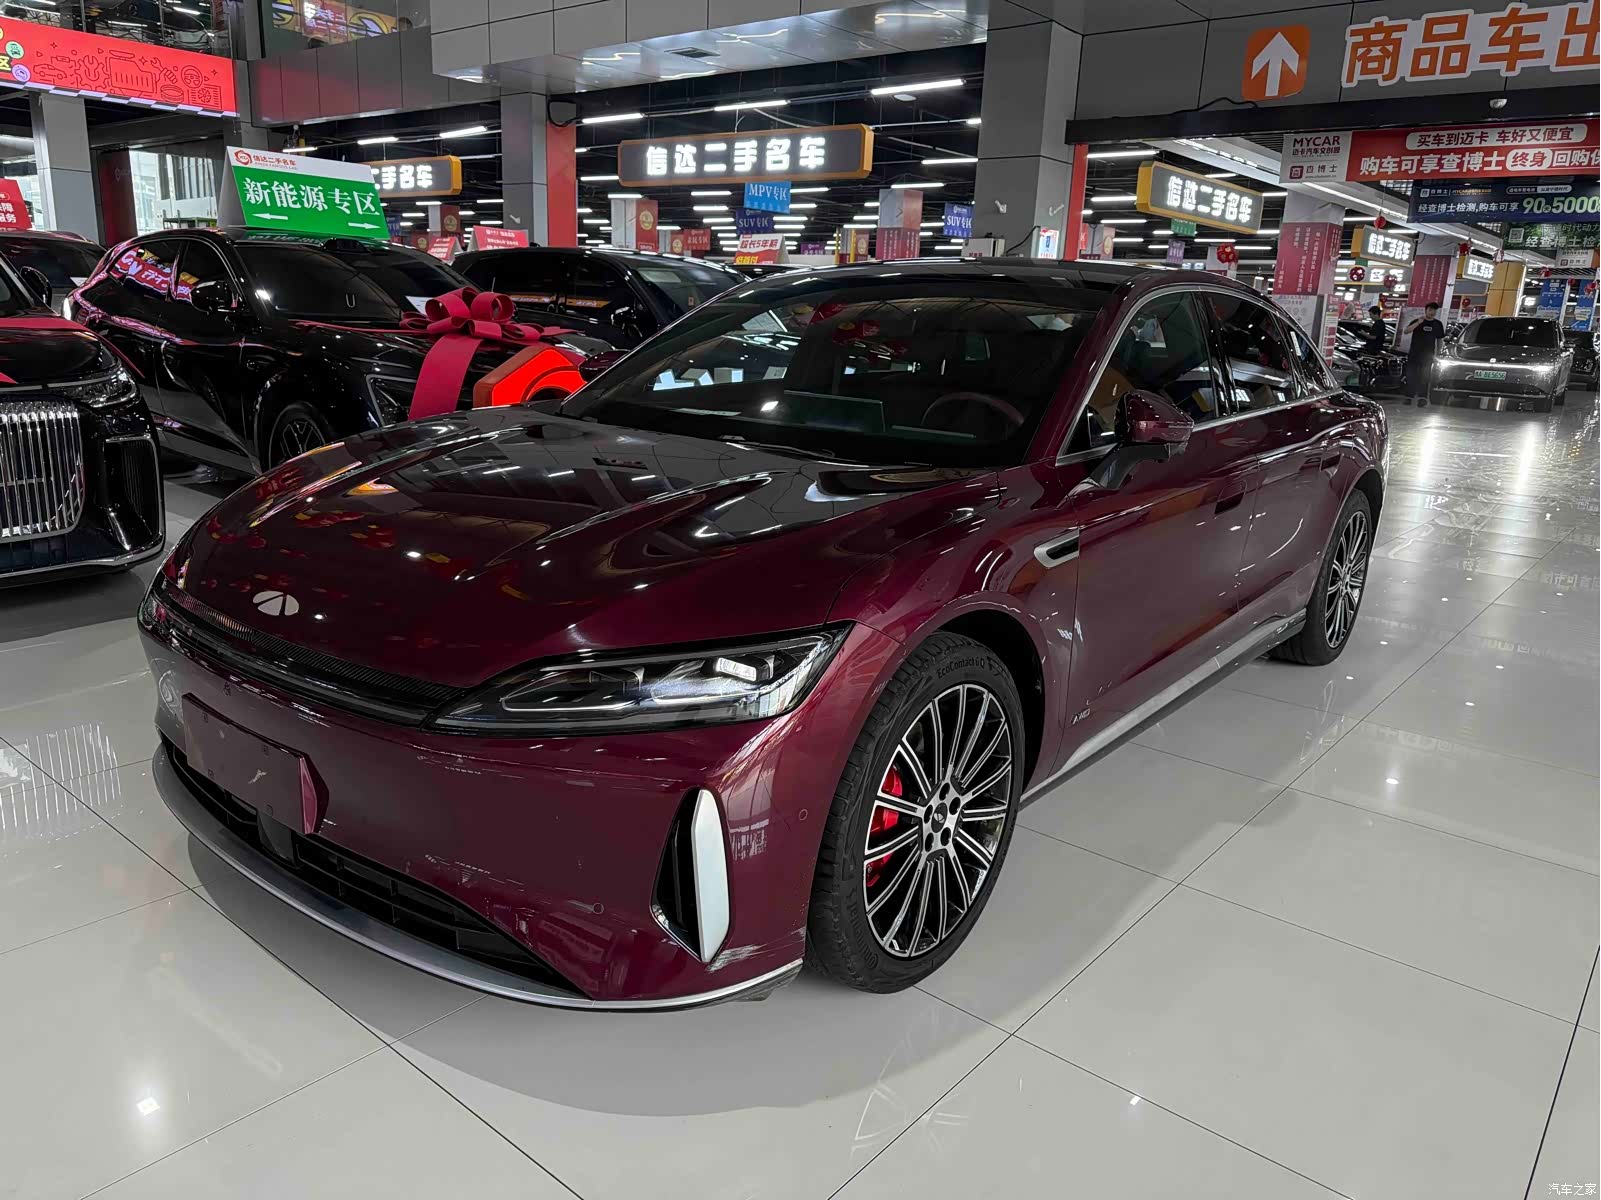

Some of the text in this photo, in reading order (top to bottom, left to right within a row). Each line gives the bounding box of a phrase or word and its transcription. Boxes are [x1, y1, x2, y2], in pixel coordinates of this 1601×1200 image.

[1293, 136, 1341, 147] MYCAR
[1417, 126, 1575, 148] 买车到迈卡 车好又便宜
[253, 154, 297, 165] 信达二手名车
[646, 137, 825, 175] 信达二手名车
[1306, 164, 1338, 173] 查博士
[242, 177, 380, 215] 新能源专区
[1167, 175, 1253, 223] 信达二手名车
[0, 203, 14, 213] 障
[1368, 232, 1411, 260] 信达二手名车
[1525, 235, 1600, 248] 经查博士检
[937, 657, 974, 679] EcoContact
